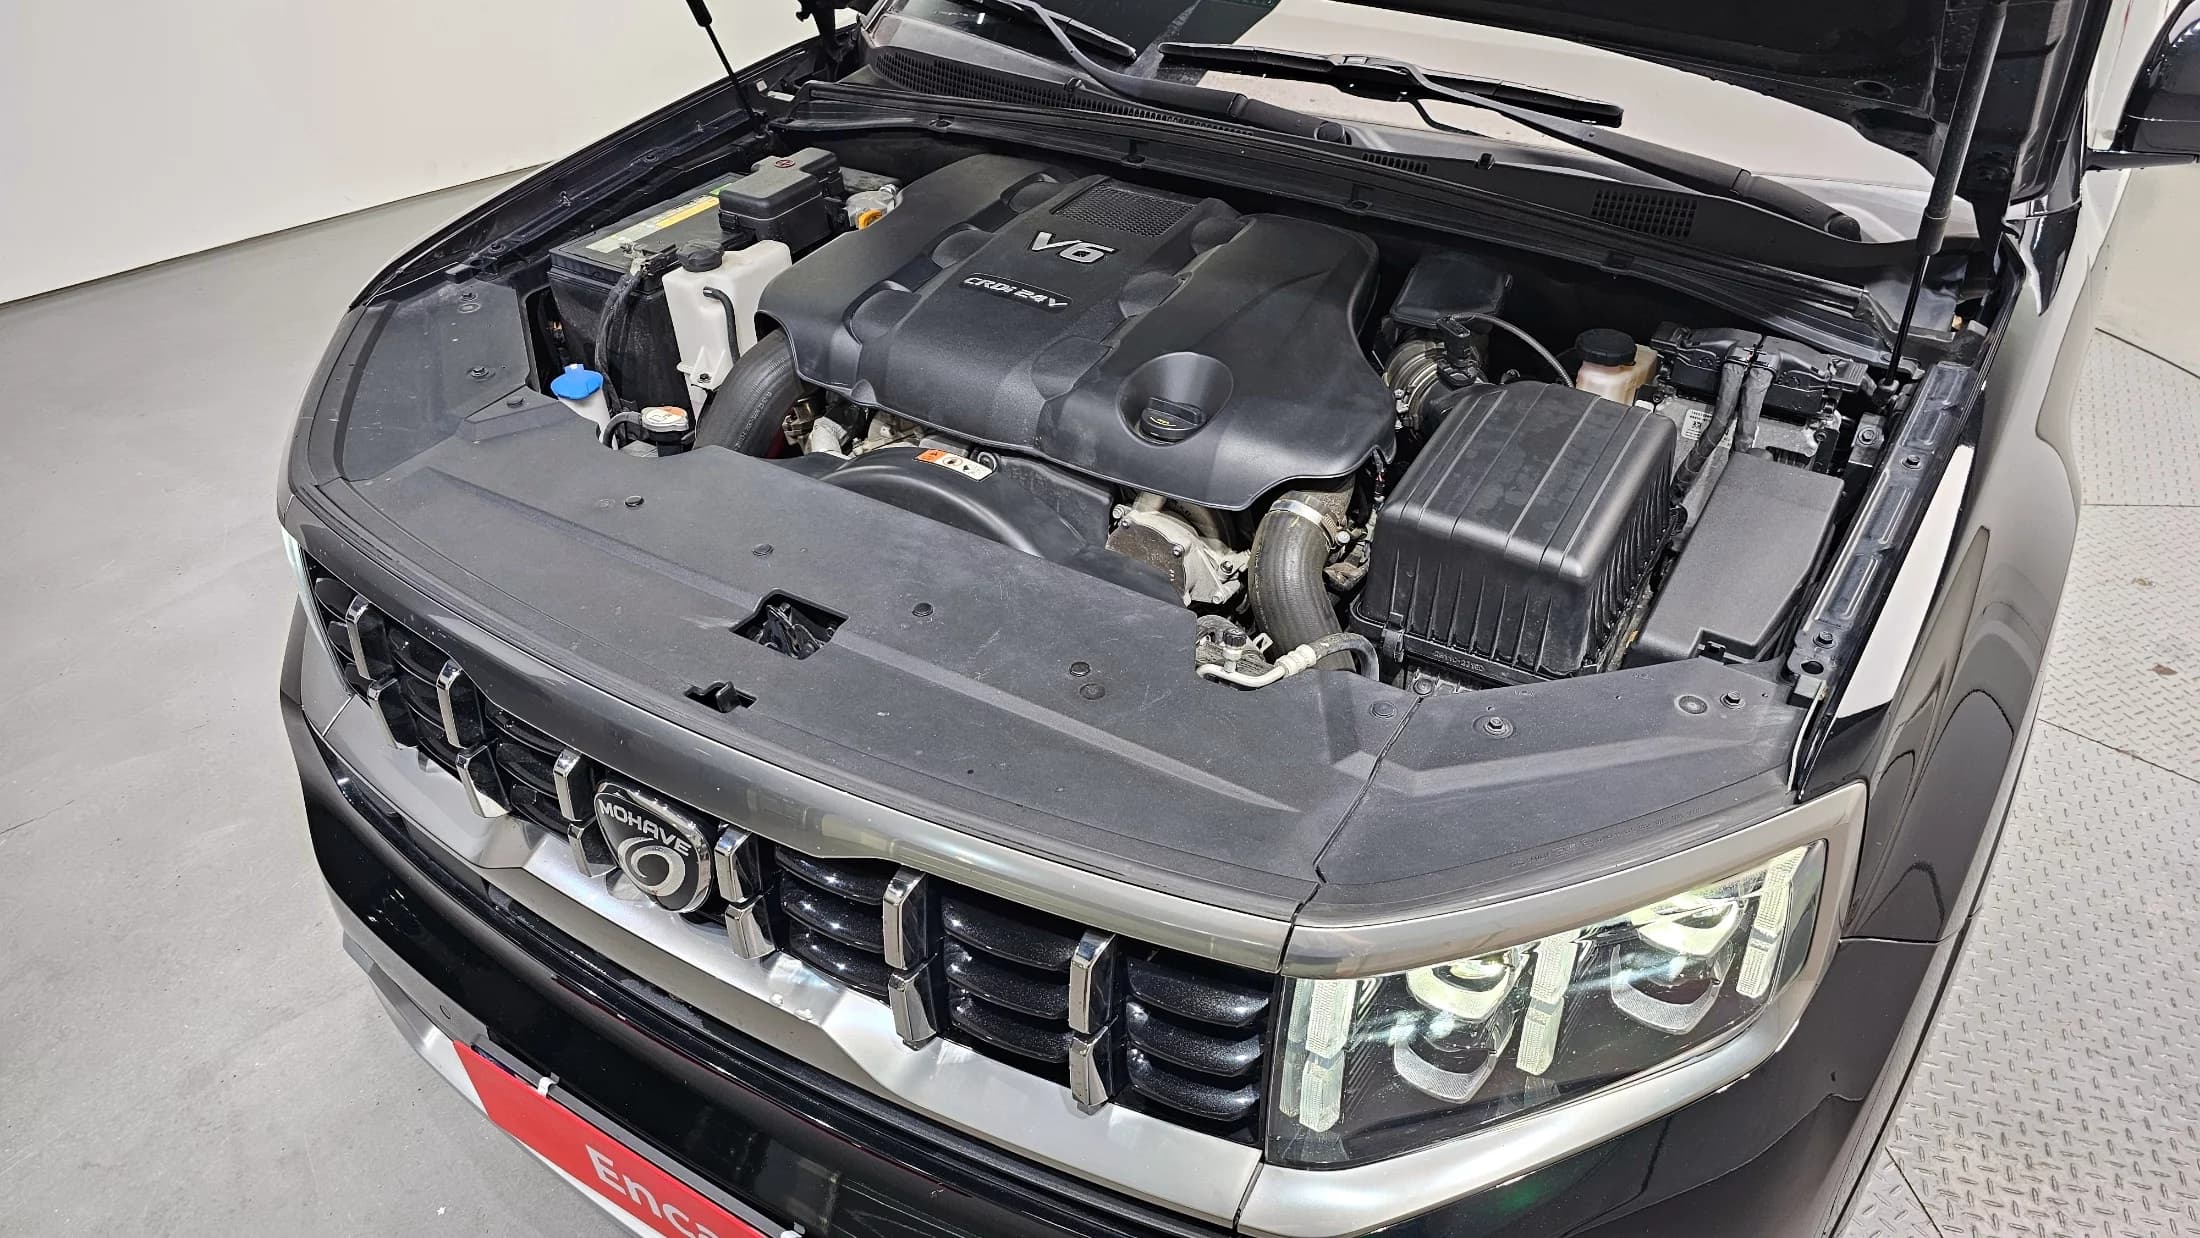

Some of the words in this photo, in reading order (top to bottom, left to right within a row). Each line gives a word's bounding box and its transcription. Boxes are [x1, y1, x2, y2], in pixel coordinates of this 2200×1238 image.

[1031, 231, 1116, 264] V6
[1013, 288, 1069, 308] 24V
[597, 798, 692, 858] MOHAVE
